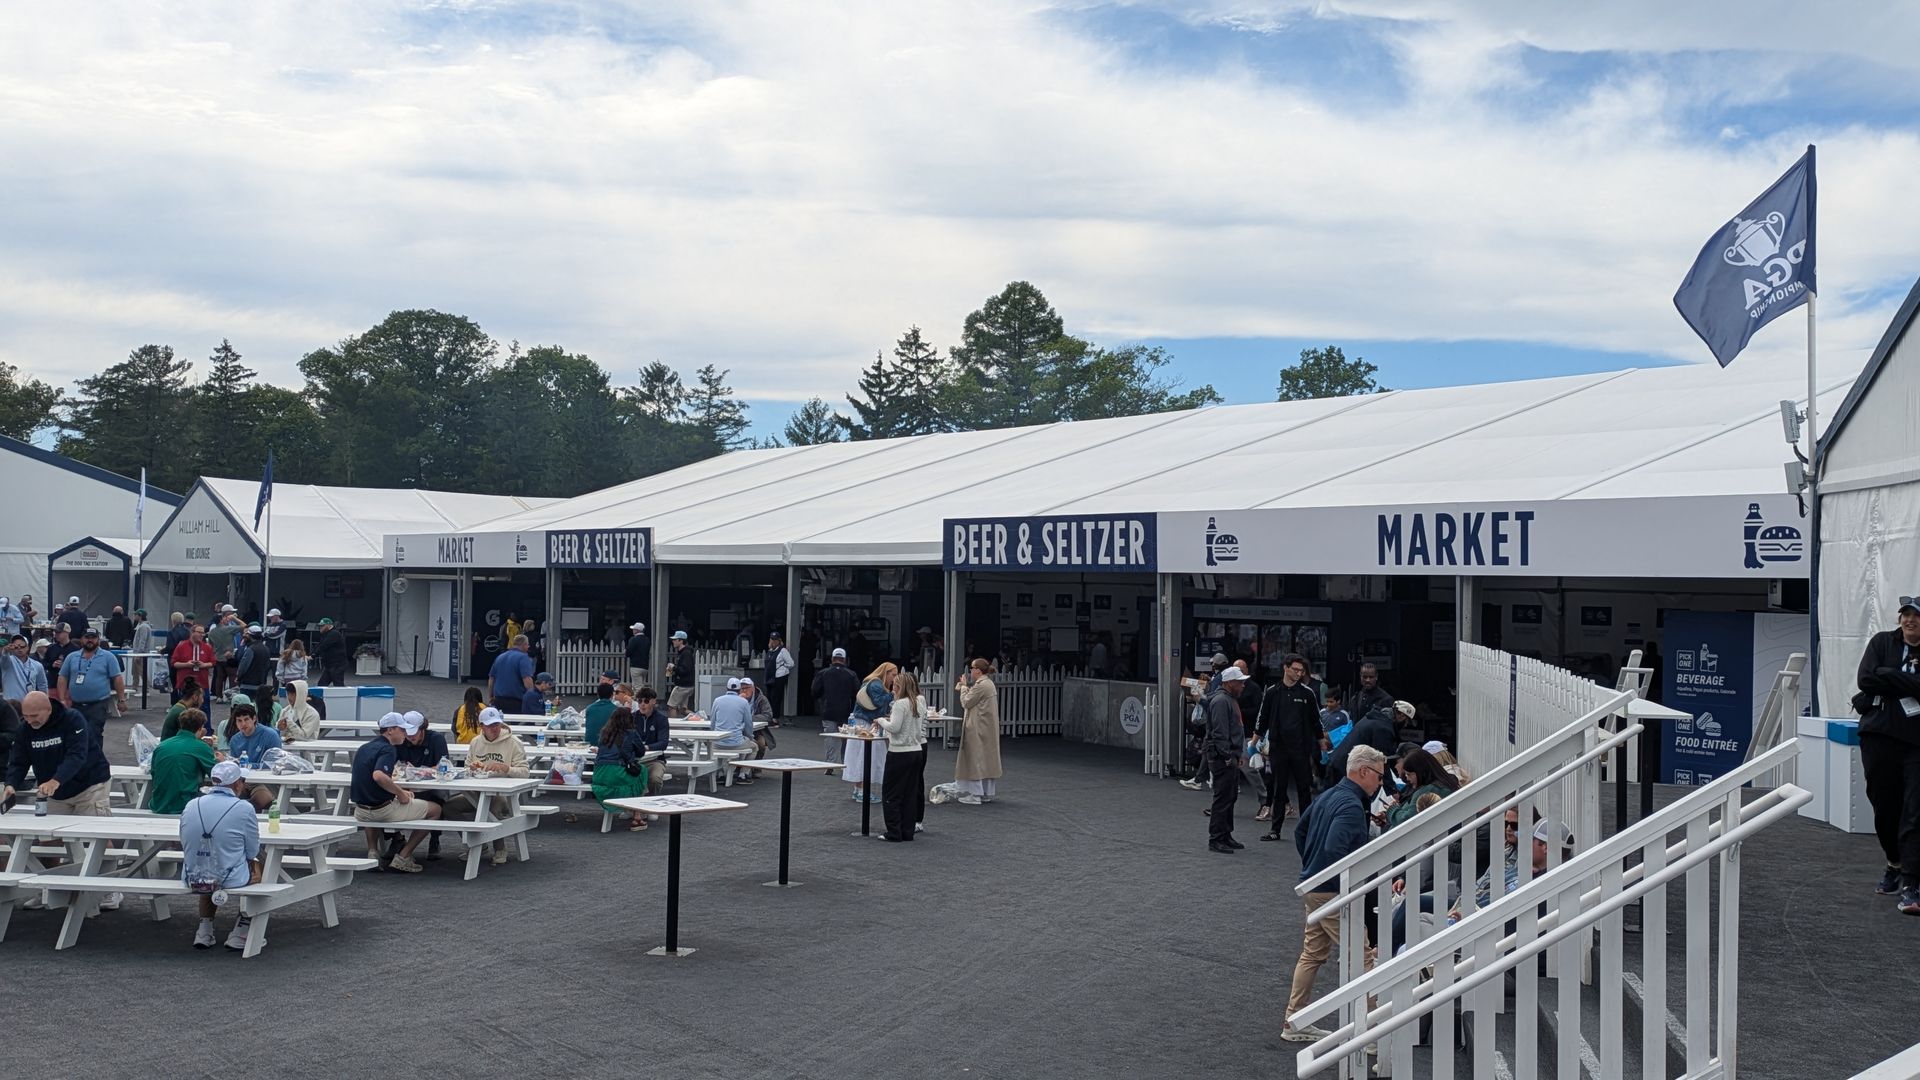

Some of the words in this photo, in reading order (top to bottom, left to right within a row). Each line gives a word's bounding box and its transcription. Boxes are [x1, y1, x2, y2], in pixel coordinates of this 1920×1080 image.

[179, 519, 203, 534] WILLIAM
[204, 518, 220, 534] HILL
[954, 523, 1008, 565] BEER
[1017, 522, 1032, 565] &
[1042, 519, 1146, 565] SELTZER
[1377, 511, 1535, 566] MARKET
[438, 537, 474, 563] MARKET
[551, 534, 579, 563] BEER
[583, 533, 591, 563] &
[595, 532, 646, 564] SELTZER
[434, 630, 446, 639] PGA
[1678, 660, 1692, 668] ONE
[1676, 673, 1725, 686] BEVERAGE
[1123, 713, 1140, 723] PGA
[1677, 723, 1691, 731] ONE
[1675, 736, 1700, 748] FOOD
[1701, 739, 1739, 752] ENTRÉE
[1677, 772, 1691, 780] PICK
